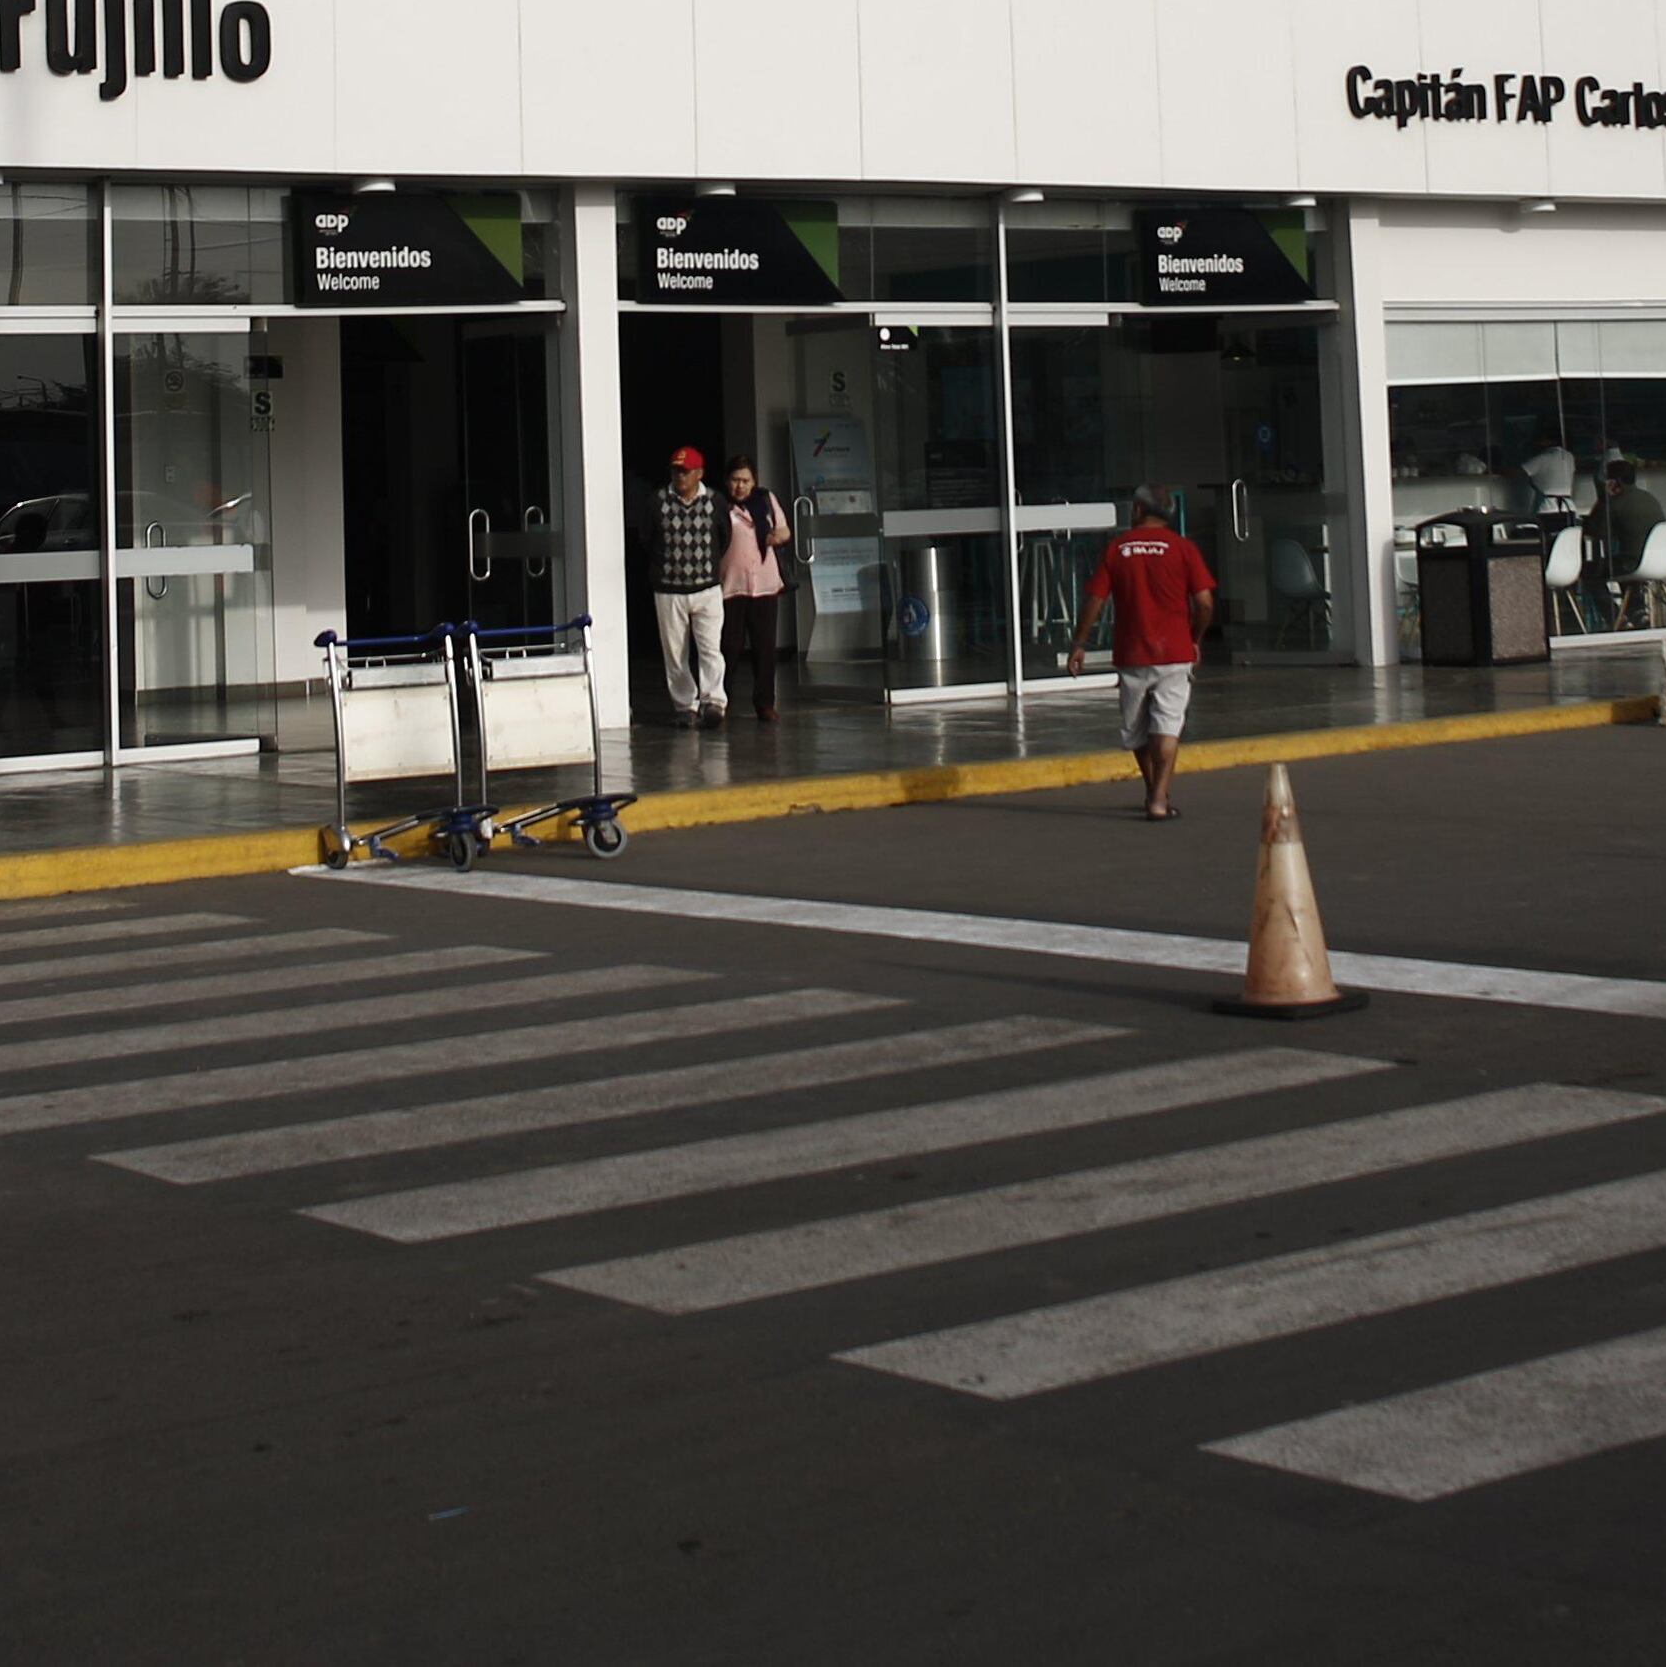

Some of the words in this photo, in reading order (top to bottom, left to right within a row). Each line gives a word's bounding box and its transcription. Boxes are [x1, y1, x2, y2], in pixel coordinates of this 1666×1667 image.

[1346, 65, 1487, 130] Capitán
[1494, 74, 1565, 124] FAP
[315, 245, 432, 269] Bienvenidos
[656, 247, 759, 271] Bienvenidos
[1157, 253, 1244, 274] Bienvenidos
[316, 273, 380, 291] Welcome
[657, 272, 714, 291] Welcome
[1158, 277, 1206, 292] Welcome
